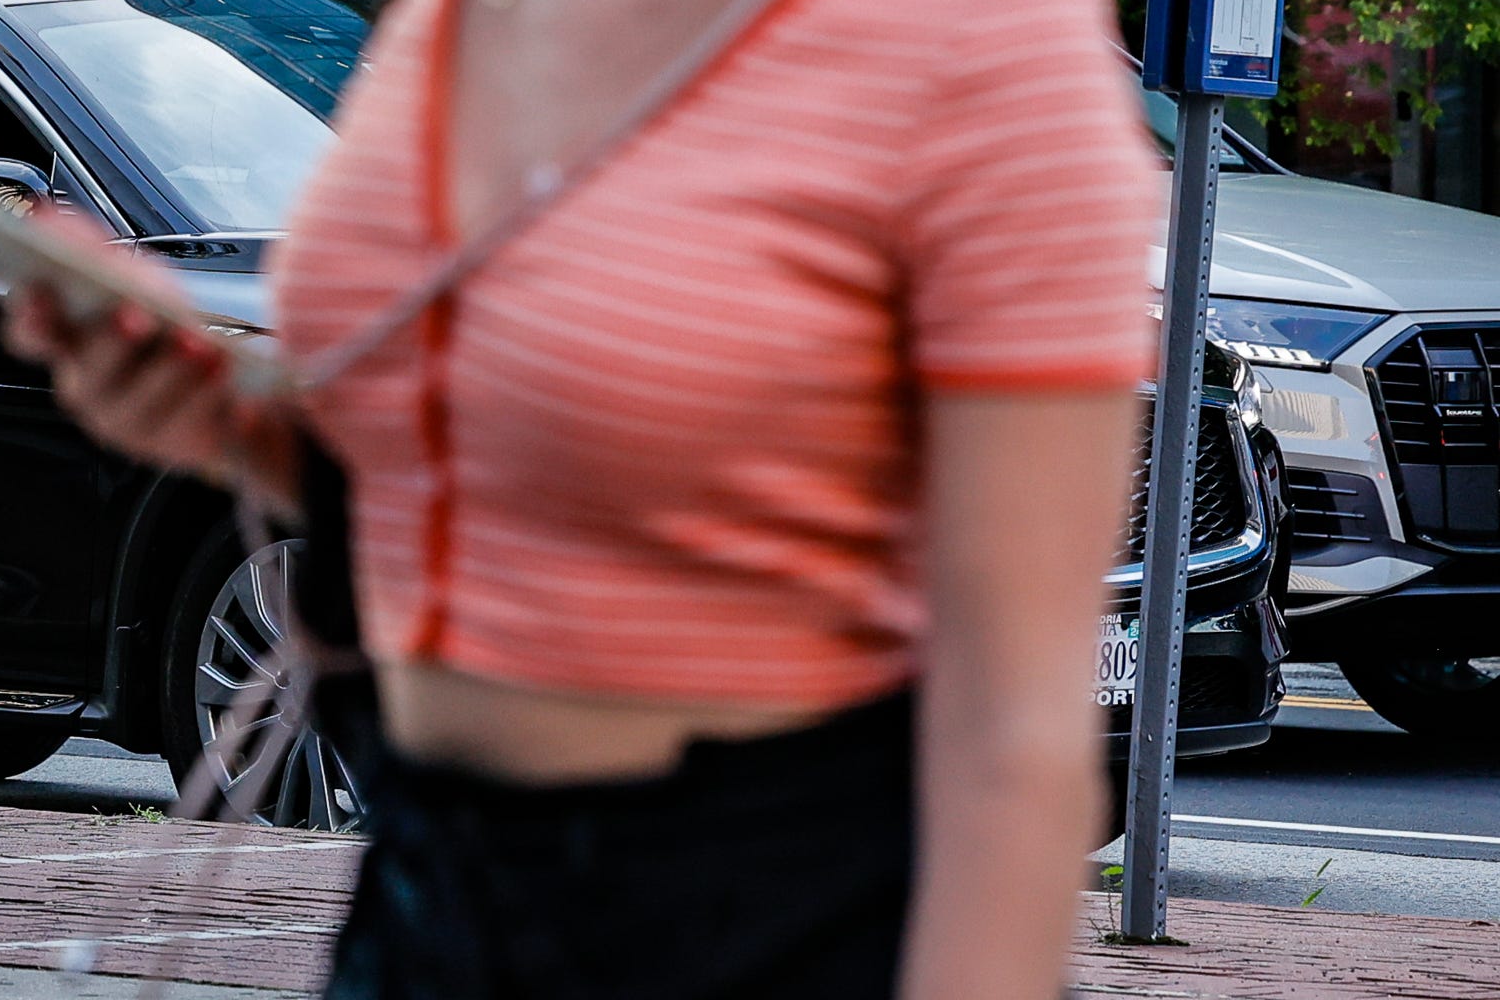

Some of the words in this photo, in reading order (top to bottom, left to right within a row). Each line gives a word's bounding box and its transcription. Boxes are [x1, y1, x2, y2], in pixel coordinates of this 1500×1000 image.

[1098, 624, 1118, 637] IA
[1100, 641, 1139, 680] 809
[1090, 689, 1135, 706] ORT
